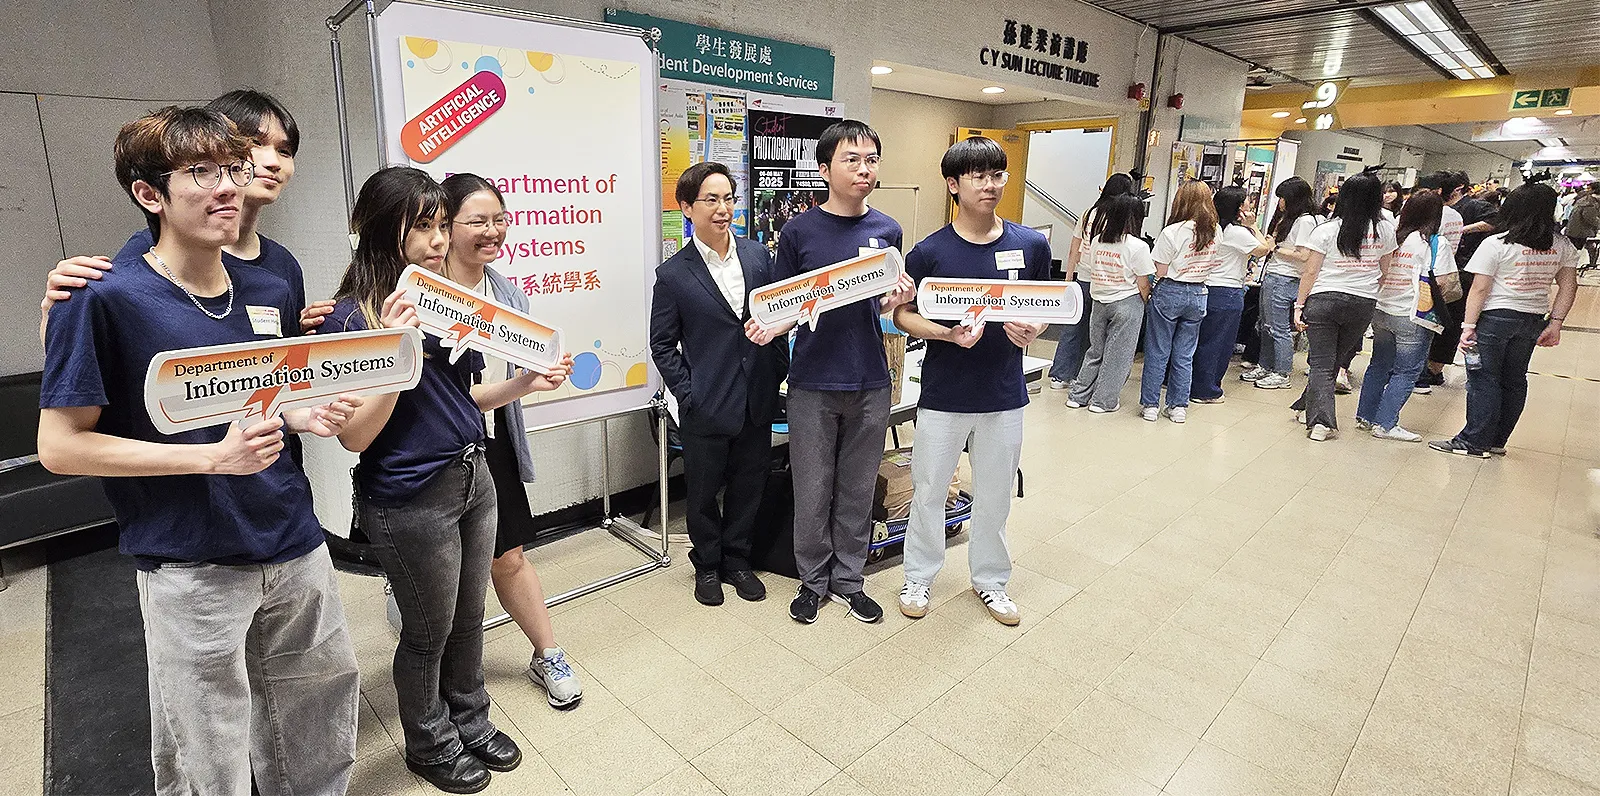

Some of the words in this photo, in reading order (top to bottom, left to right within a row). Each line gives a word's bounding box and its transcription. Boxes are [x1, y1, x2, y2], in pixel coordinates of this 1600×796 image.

[695, 33, 773, 66] 學生發展處
[657, 53, 689, 73] dent
[692, 58, 774, 86] Development
[776, 71, 818, 91] Services
[1001, 52, 1023, 72] SUN
[1025, 58, 1064, 80] LECTURE
[1065, 66, 1100, 88] THEATRE
[418, 83, 484, 136] ARTIFICIAL
[418, 89, 501, 156] INTELLIGENCE
[754, 136, 801, 160] PHOTOGRAPHY
[595, 174, 618, 194] of
[758, 177, 784, 187] 2025
[503, 205, 603, 227] ormation
[416, 277, 466, 304] Department
[466, 299, 476, 309] of
[507, 269, 602, 297] 系統學系
[760, 285, 801, 302] Department
[802, 279, 811, 288] of
[767, 284, 835, 314] Information
[837, 268, 885, 291] Systems
[931, 284, 975, 293] Department
[976, 285, 984, 293] of
[935, 294, 1006, 306] Information
[1009, 295, 1061, 308] Systems
[417, 292, 495, 334] Information
[498, 325, 546, 353] Systems
[174, 356, 258, 377] Department
[261, 352, 275, 365] of
[184, 364, 315, 401] Information
[320, 354, 395, 380] Systems
